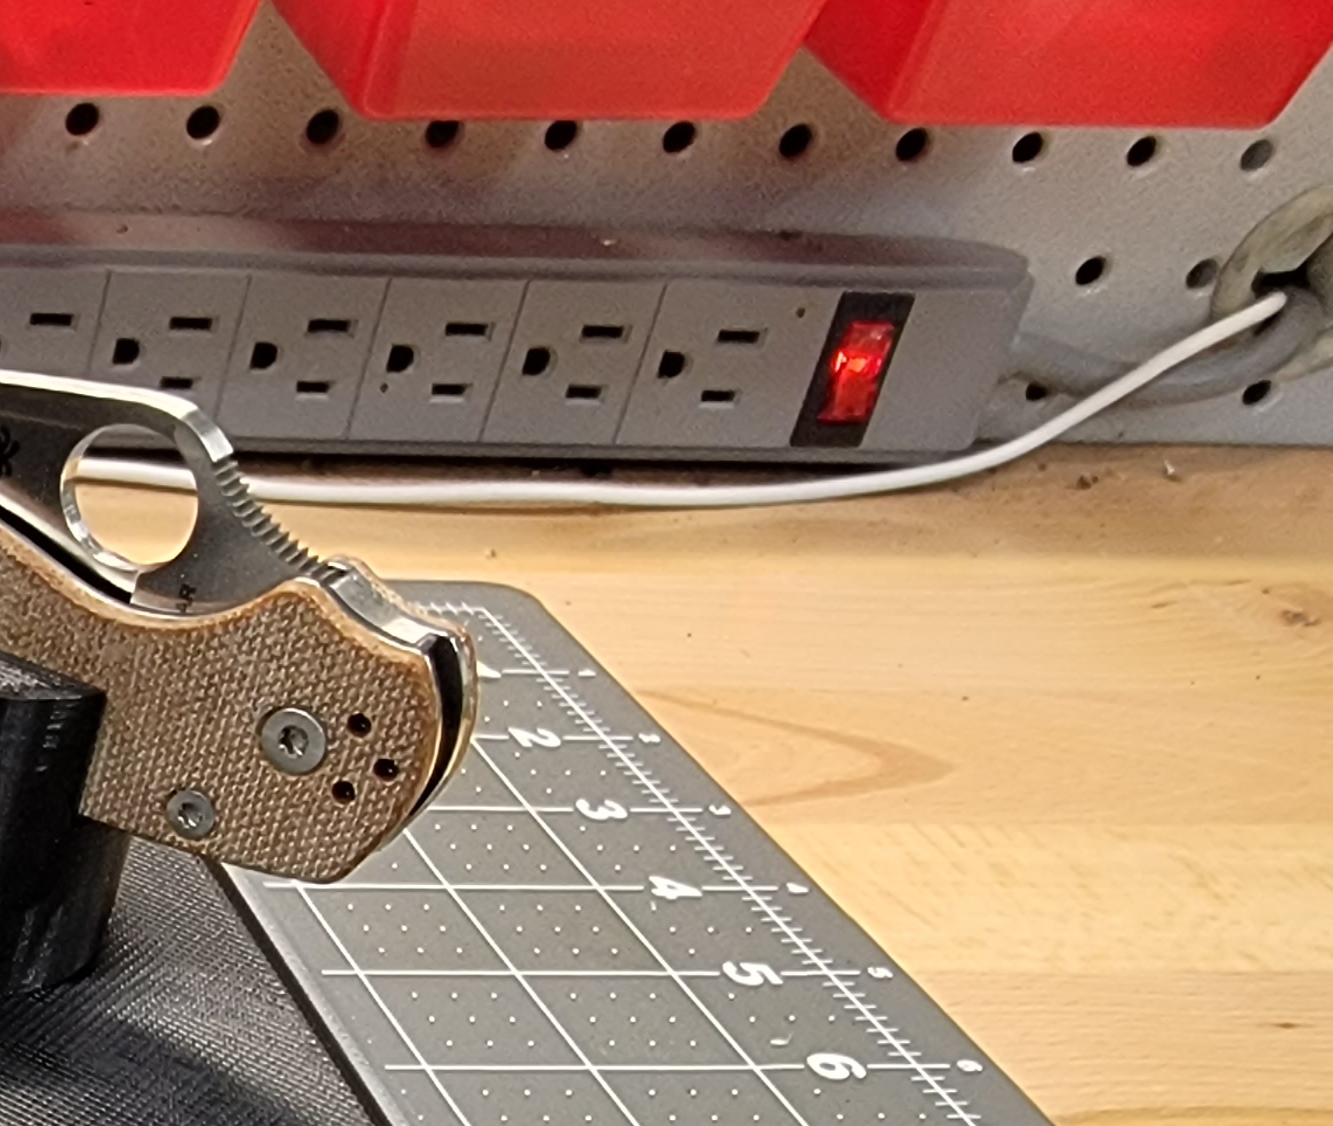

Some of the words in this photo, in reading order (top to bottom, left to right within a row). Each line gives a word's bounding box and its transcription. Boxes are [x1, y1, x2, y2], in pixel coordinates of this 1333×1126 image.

[508, 727, 561, 747] 2
[576, 799, 628, 820] 3
[648, 875, 703, 900] 4
[722, 961, 783, 986] 5
[807, 1053, 867, 1080] 6
[956, 1059, 983, 1073] 6
